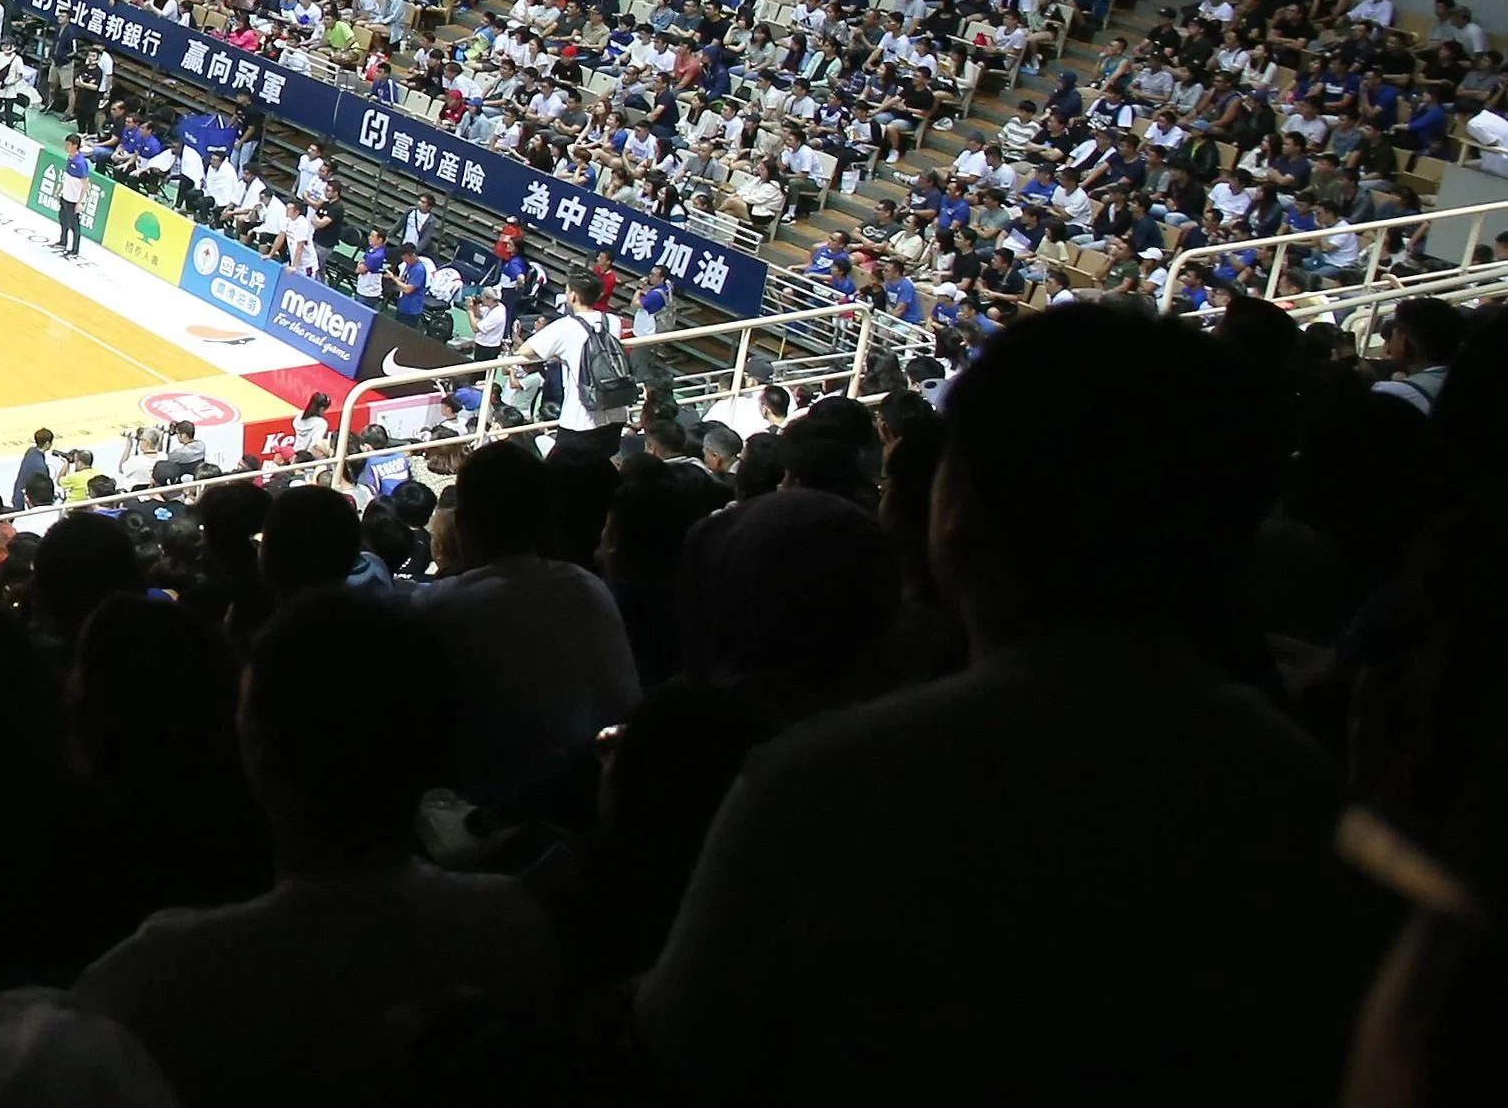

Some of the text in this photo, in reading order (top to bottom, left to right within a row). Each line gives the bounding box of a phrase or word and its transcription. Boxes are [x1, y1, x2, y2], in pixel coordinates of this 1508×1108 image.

[180, 38, 286, 105] 贏向冠軍
[520, 180, 730, 295] 為中華隊加油
[273, 312, 352, 362] For the real game
[281, 288, 358, 347] molten
